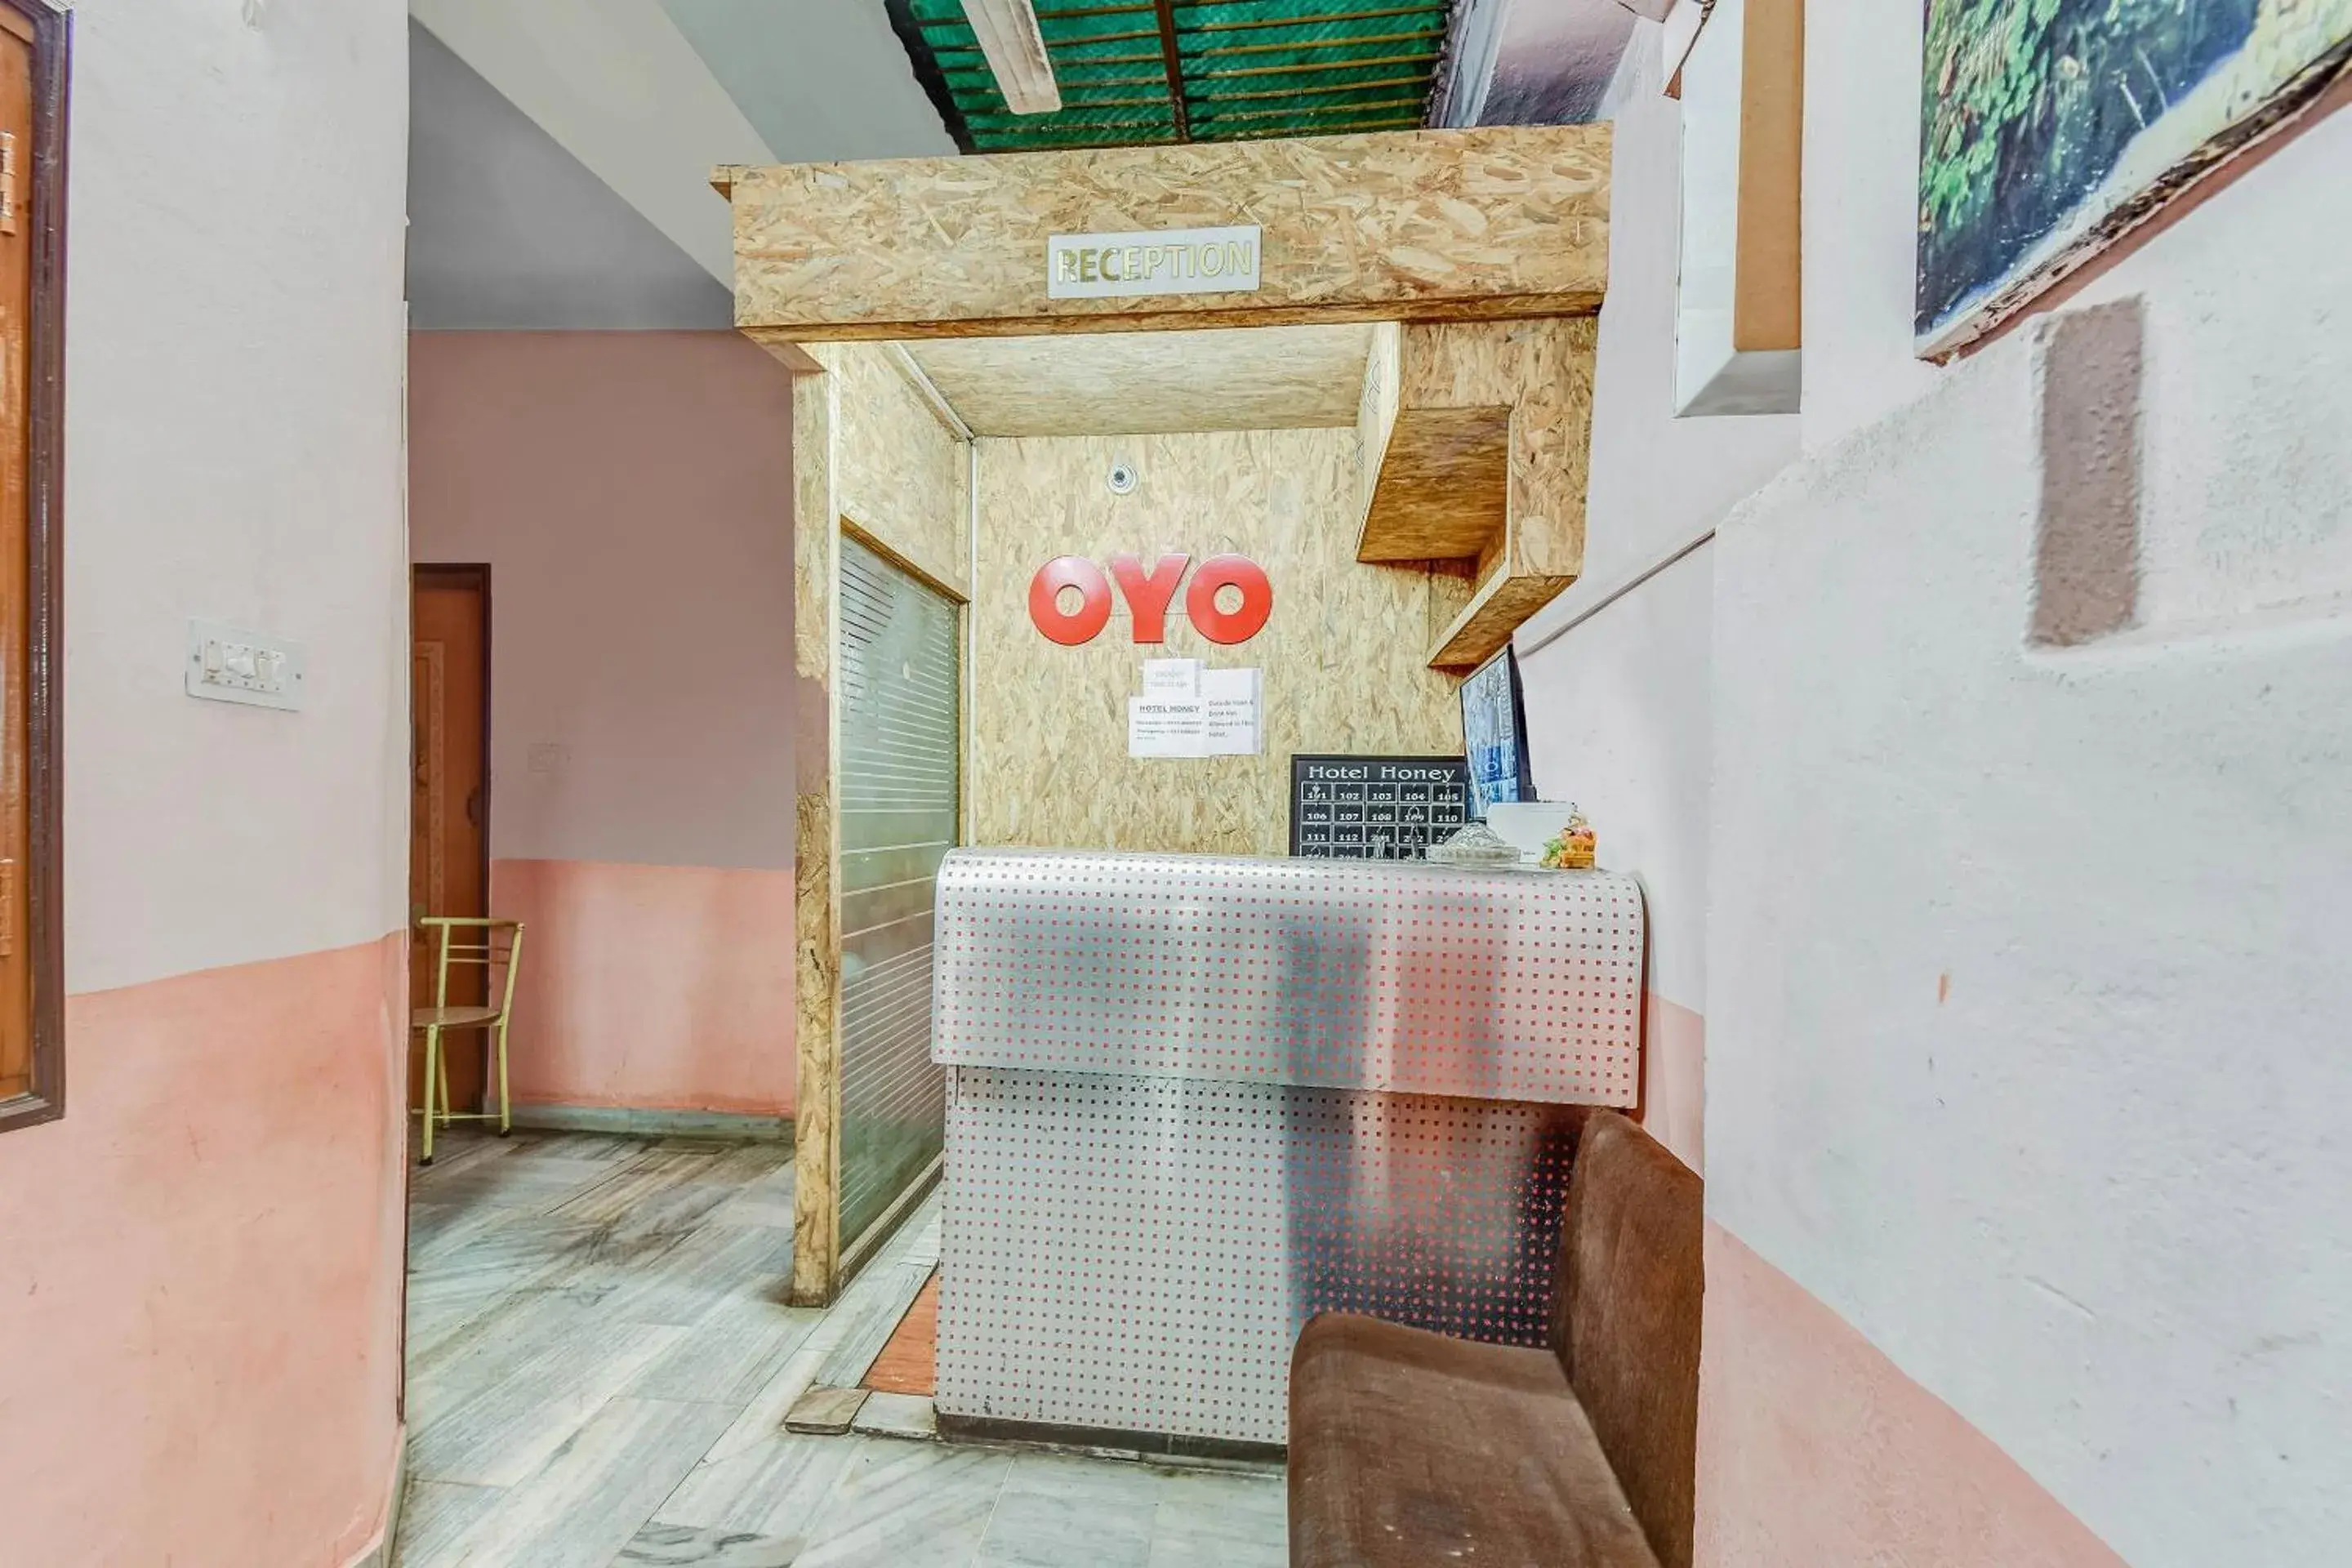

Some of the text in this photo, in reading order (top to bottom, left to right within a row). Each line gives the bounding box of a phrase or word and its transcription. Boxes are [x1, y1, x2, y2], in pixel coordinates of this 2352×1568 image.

[1056, 241, 1253, 283] RECEPTION
[1028, 553, 1272, 646] OYO
[1139, 705, 1200, 713] HOTEL HONEY
[1308, 765, 1456, 783] Hotel Honey
[1339, 792, 1360, 800] 102
[1307, 813, 1327, 821] 106
[1339, 813, 1359, 821] 107
[1437, 814, 1458, 822] 110
[1307, 833, 1326, 841] 111
[1339, 833, 1359, 841] 112
[1403, 835, 1423, 843] 22
